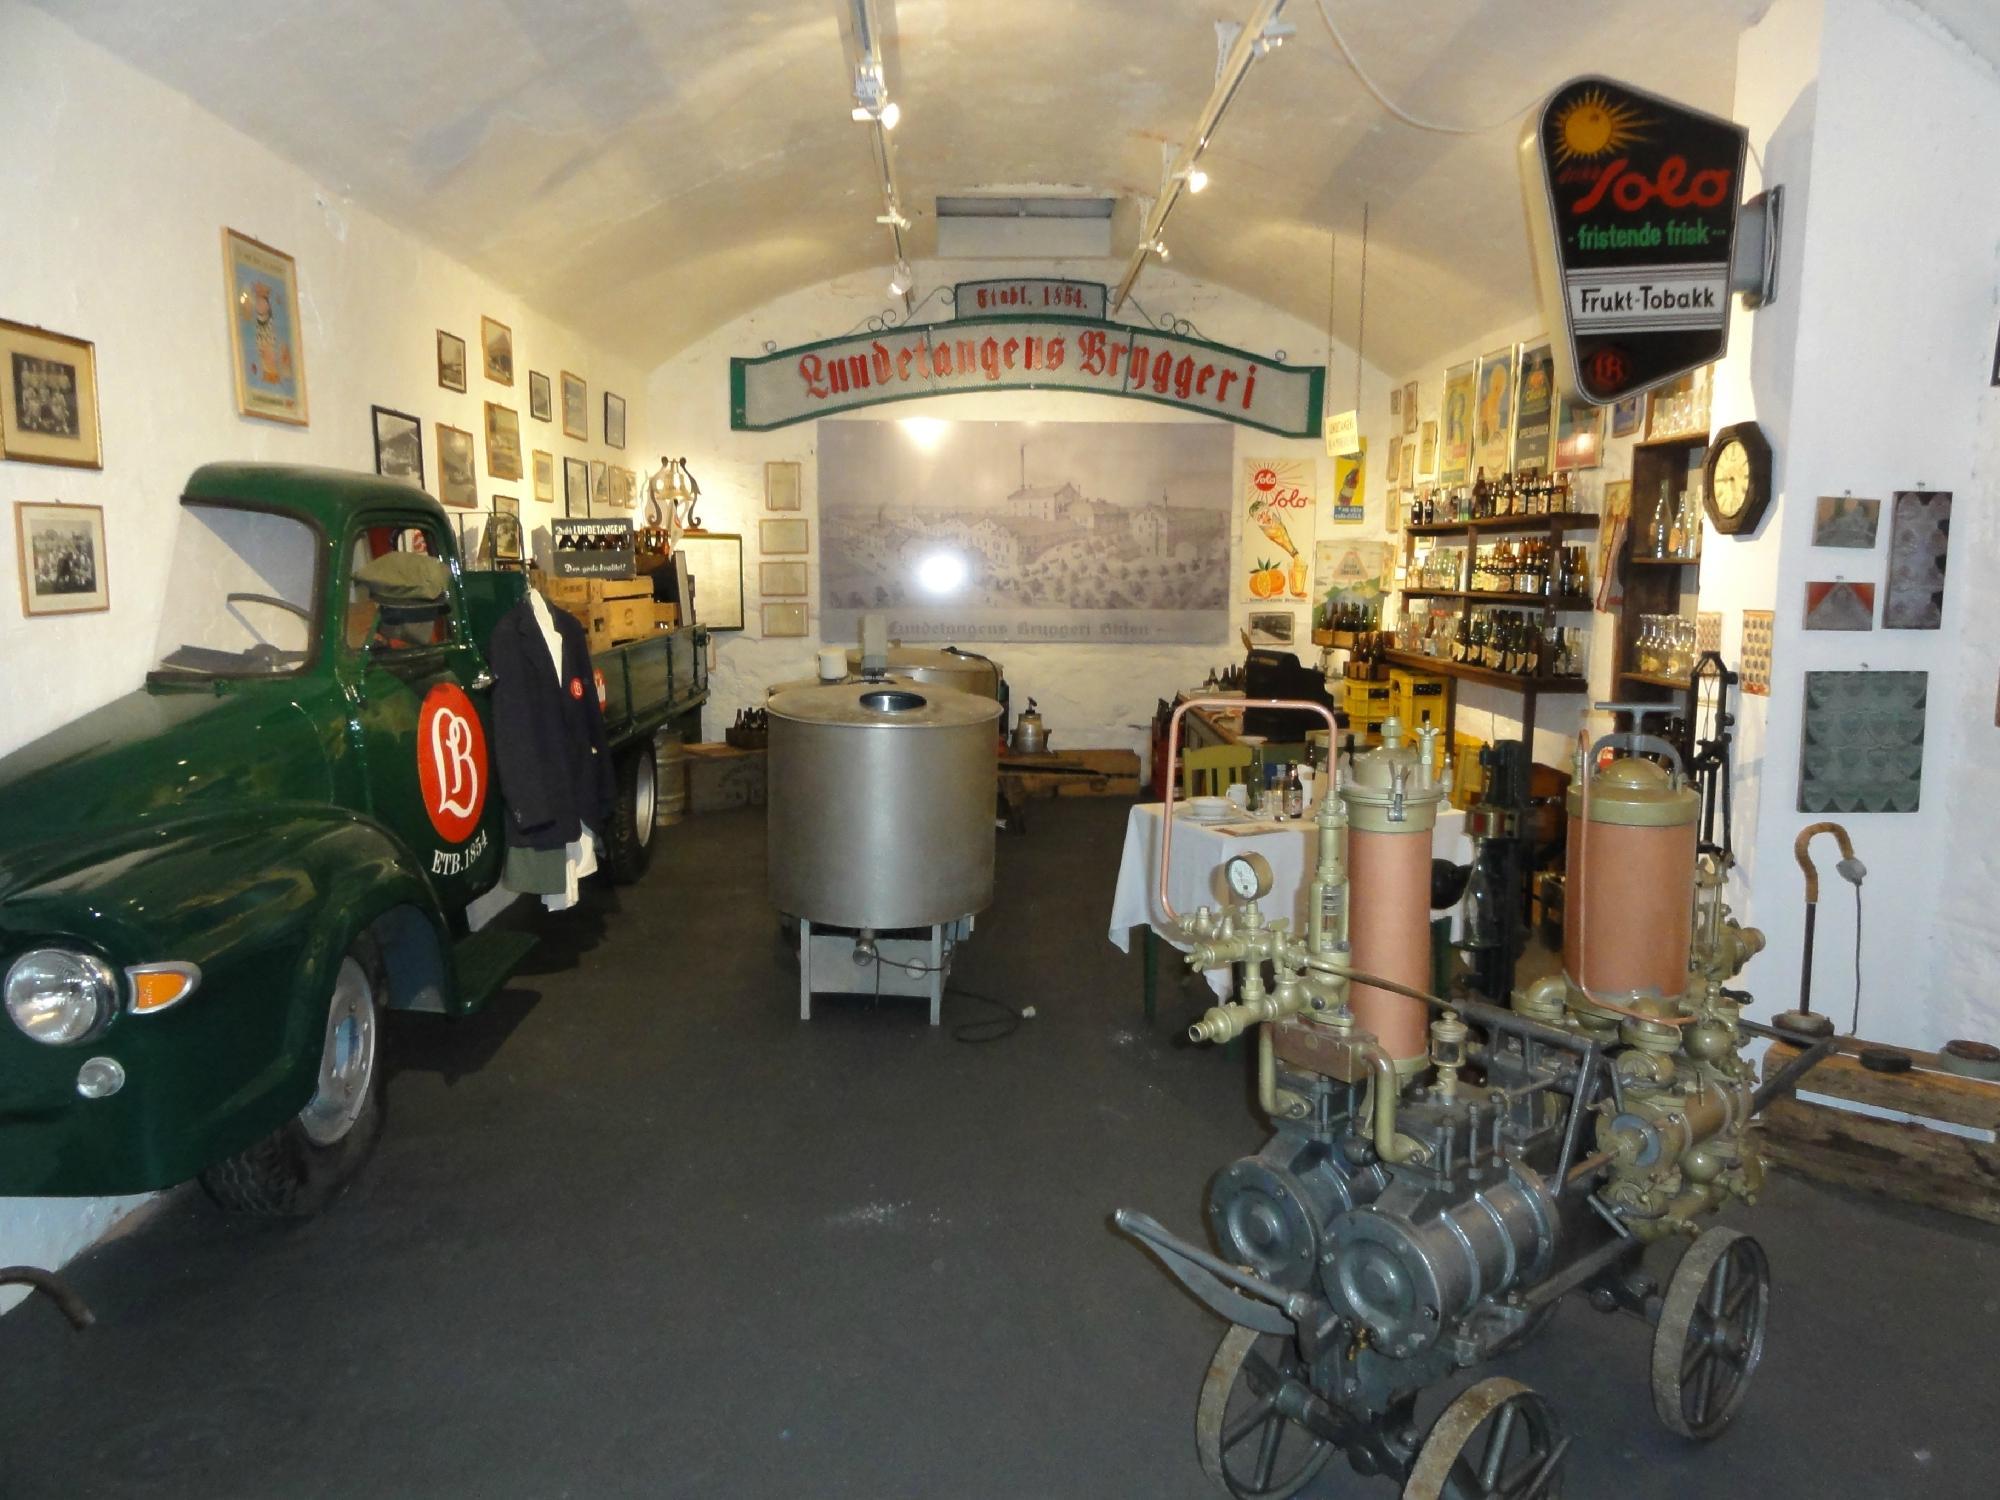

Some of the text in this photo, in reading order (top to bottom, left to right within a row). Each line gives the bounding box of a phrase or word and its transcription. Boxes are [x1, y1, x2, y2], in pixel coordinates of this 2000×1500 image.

[1572, 155, 1732, 215] Solo
[1577, 218, 1709, 250] fristende frisk
[1581, 285, 1715, 313] Frukt-Tobakk
[799, 330, 1257, 409] Lundetangens Bryggeri
[1268, 488, 1308, 508] Solo
